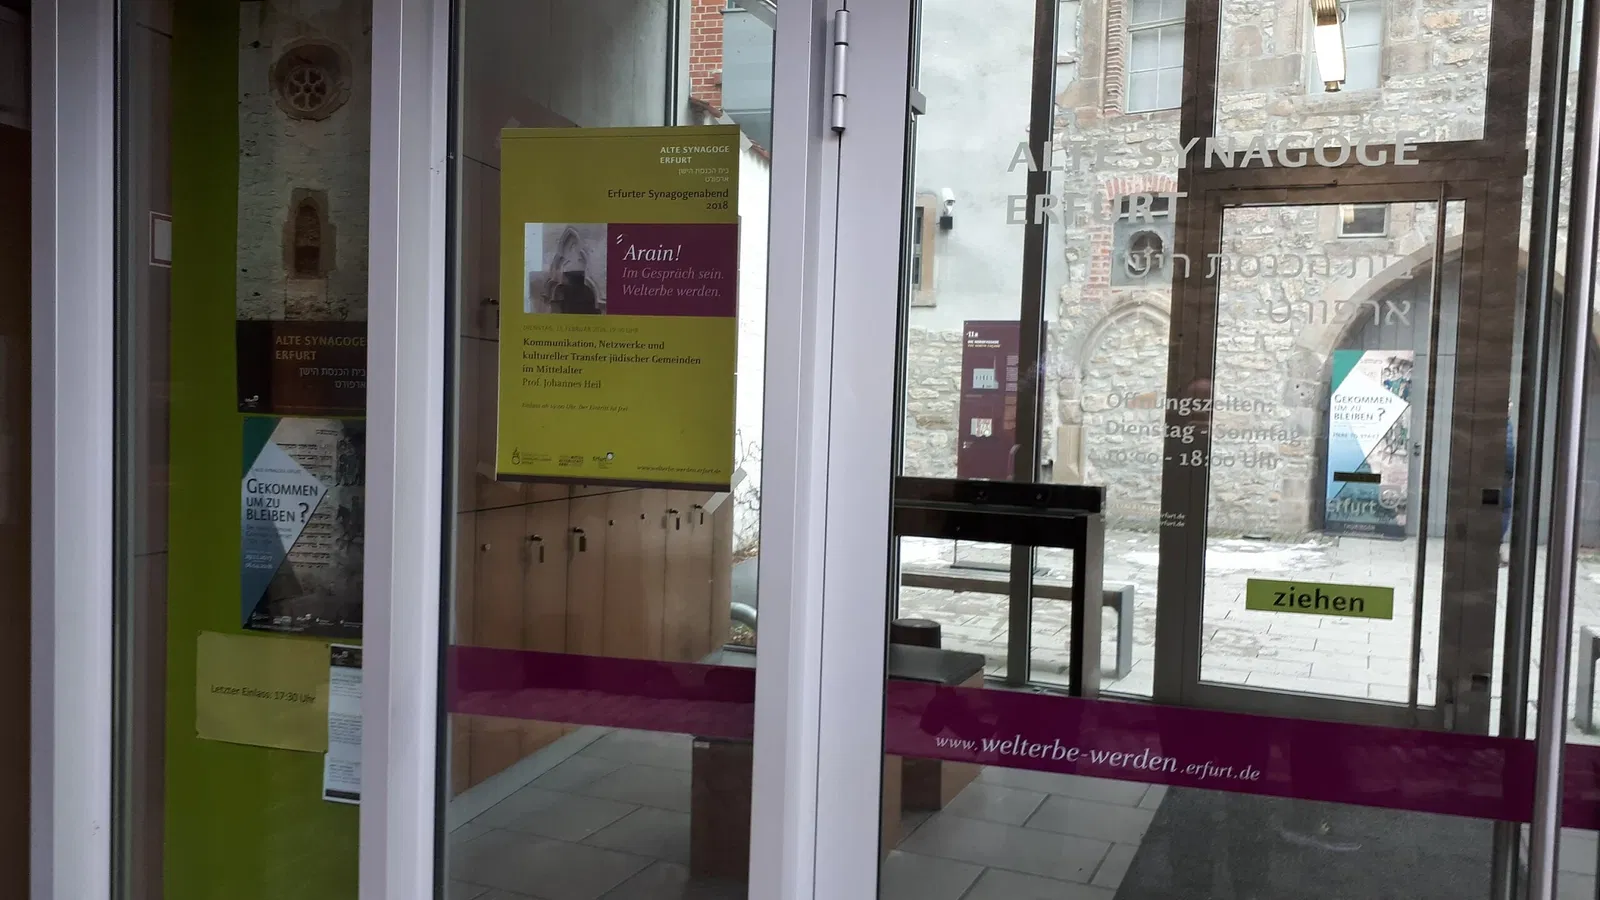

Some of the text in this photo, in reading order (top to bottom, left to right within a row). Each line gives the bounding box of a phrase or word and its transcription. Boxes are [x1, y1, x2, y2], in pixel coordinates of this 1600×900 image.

[660, 146, 730, 154] ALTE SYNAGOGE
[1007, 133, 1420, 172] ALTE SYNAGOGE
[660, 156, 692, 164] ERFURT
[608, 189, 729, 201] Erfurter Synagogenabend
[706, 201, 728, 210] 2018
[1006, 191, 1188, 225] ERFURT
[622, 244, 682, 262] Arain!
[622, 267, 724, 282] Im Gespräch sein.
[622, 284, 721, 297] Welterbe werden.
[276, 336, 366, 346] ALTE SYNAGOGE
[523, 338, 665, 350] Kommunikation, Netzwerke und
[276, 350, 316, 360] ERFURT
[522, 351, 701, 365] kultureller Transfer jüdischer Gemeinden
[522, 365, 583, 374] im Mittelalter
[522, 378, 601, 389] Prof. Johannes Heil
[1334, 394, 1392, 404] GEKOMMEN
[1334, 412, 1374, 421] BLEIBEN
[1376, 407, 1386, 422] ?
[1106, 418, 1196, 444] Dienstag
[1214, 423, 1303, 448] Sonntag
[246, 478, 318, 496] GEKOMMEN
[246, 497, 309, 523] UM ZU ?
[246, 509, 295, 522] BLEIBEN
[1272, 587, 1365, 613] ziehen
[210, 684, 240, 695] Letzter
